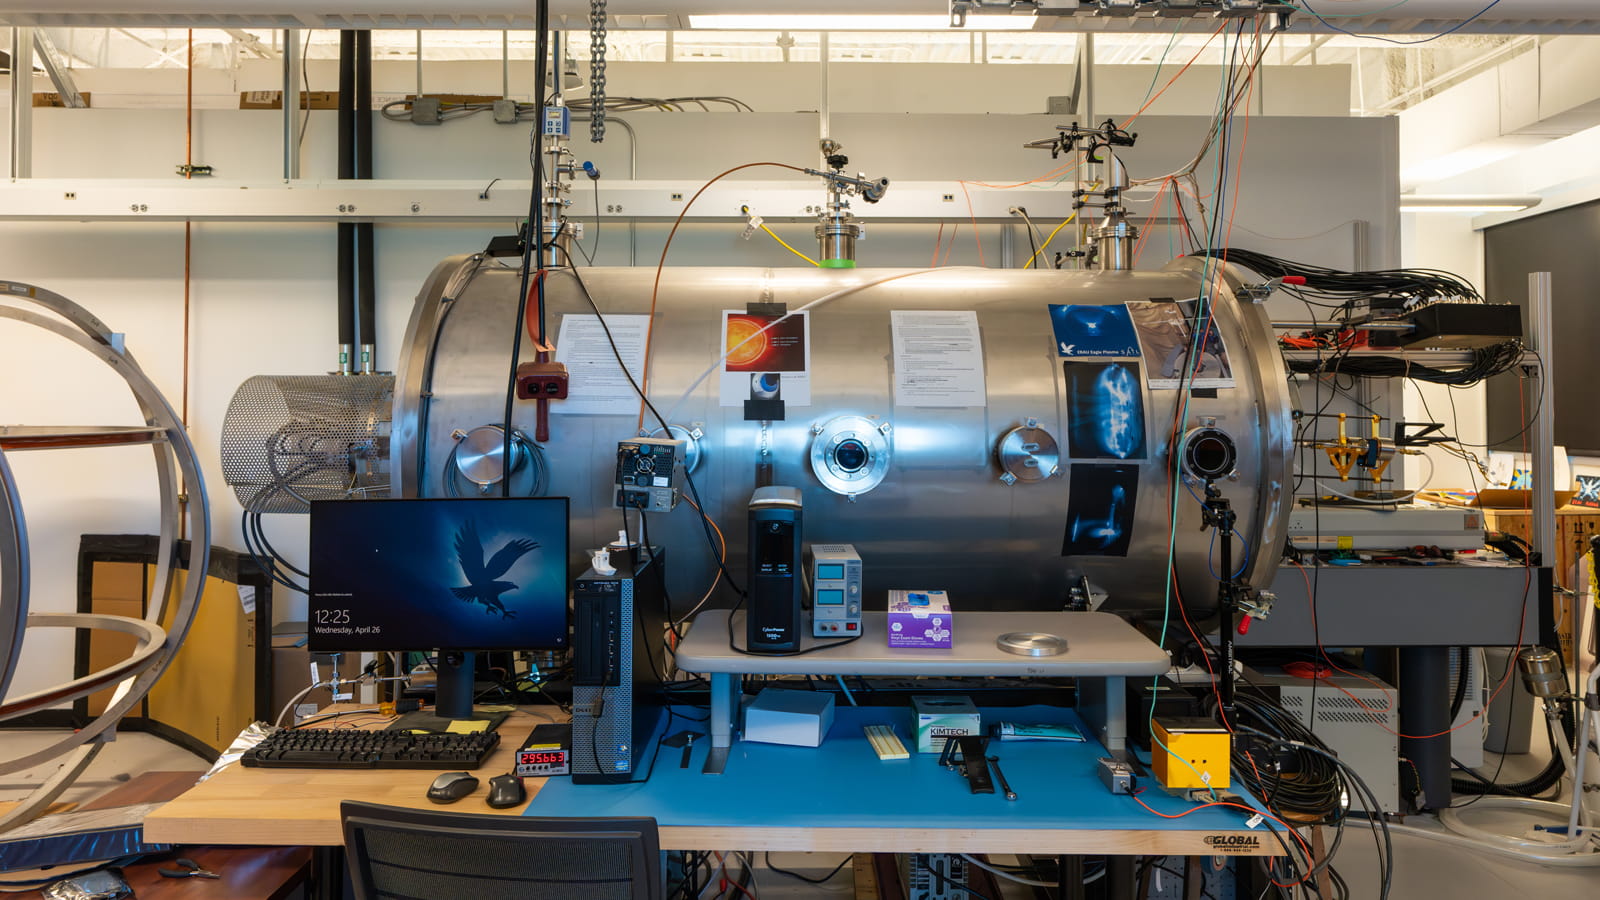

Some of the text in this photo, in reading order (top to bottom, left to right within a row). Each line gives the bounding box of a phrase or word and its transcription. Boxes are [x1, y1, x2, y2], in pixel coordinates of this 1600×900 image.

[314, 609, 350, 624] 12:25
[314, 626, 381, 635] Wednesday, April 26
[930, 728, 969, 736] KIMTECH
[1213, 835, 1260, 845] GLOBAL
